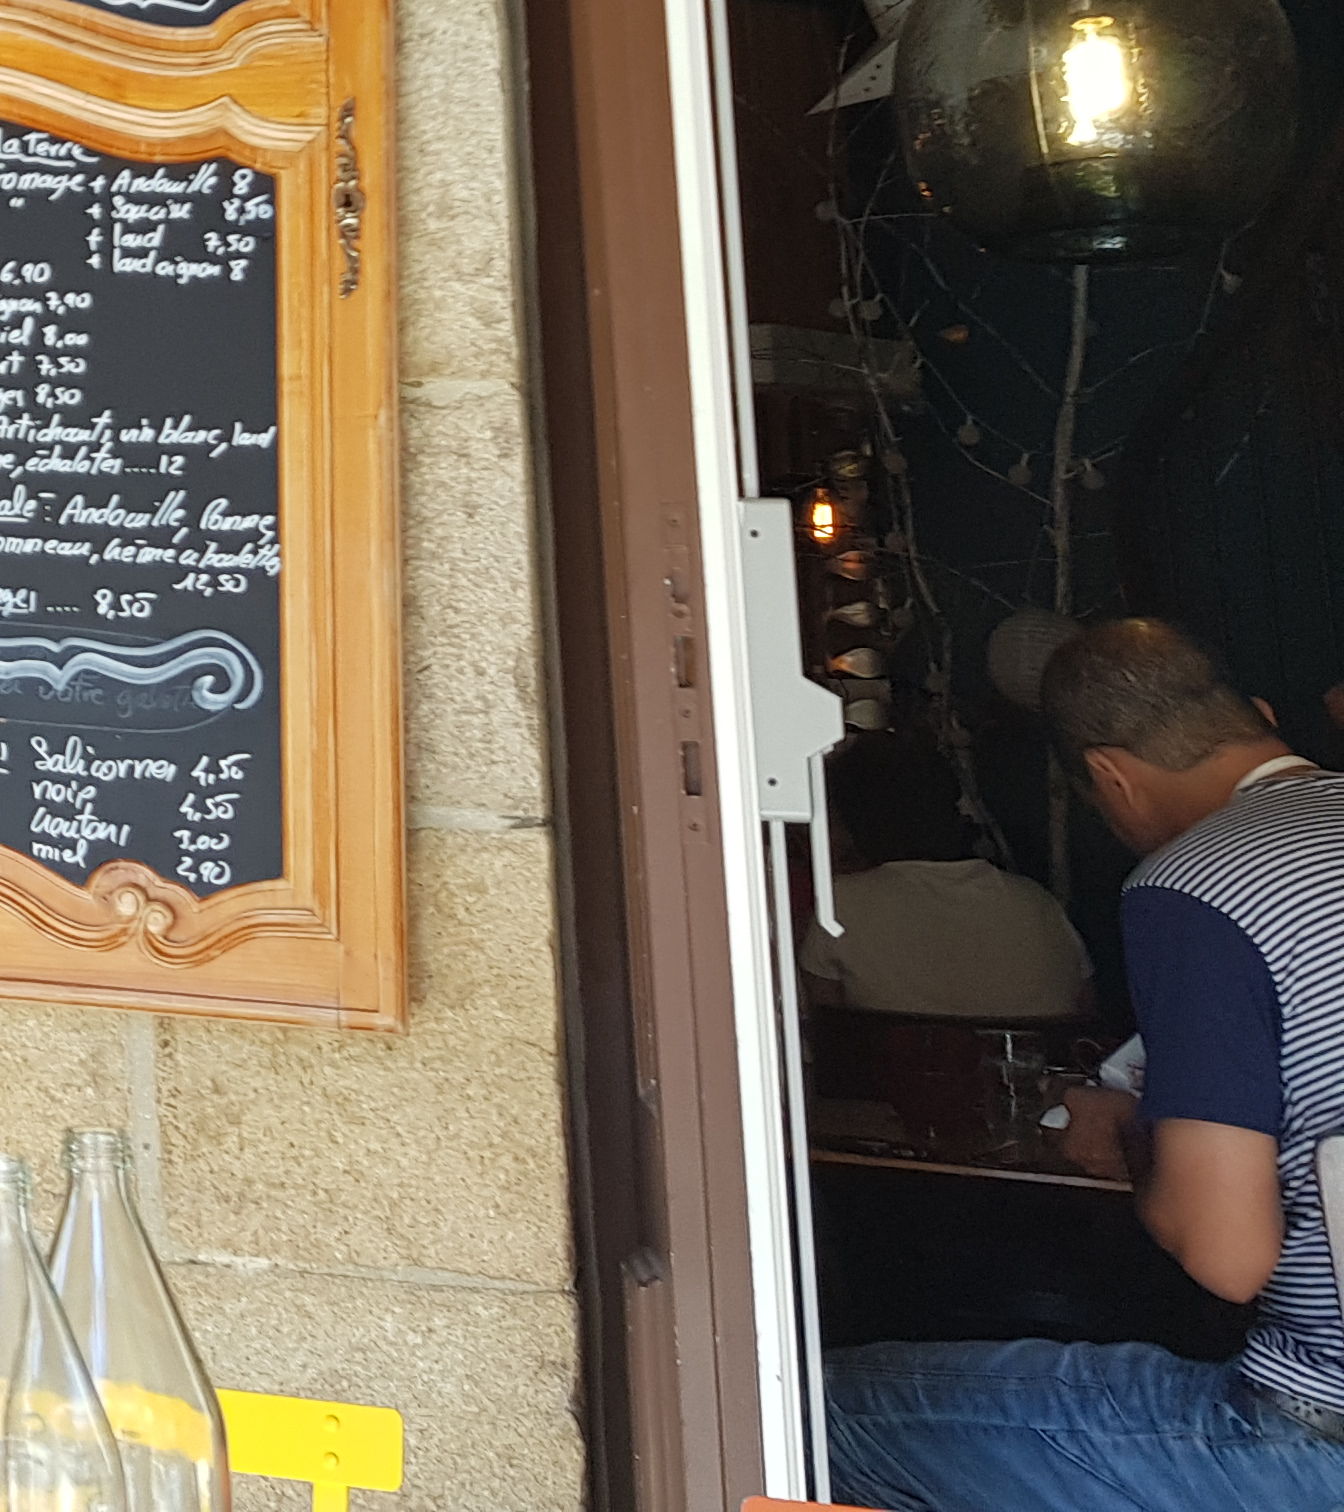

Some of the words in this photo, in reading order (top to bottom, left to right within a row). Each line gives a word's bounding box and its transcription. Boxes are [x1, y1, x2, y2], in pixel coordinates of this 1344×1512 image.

[110, 162, 219, 194] Andouille
[231, 167, 255, 195] 8
[222, 194, 274, 226] 8,50
[228, 258, 249, 282] 8
[119, 418, 156, 442] vin
[160, 455, 186, 474] 12
[172, 572, 250, 597] 12,50
[93, 588, 158, 619] 8,50
[30, 736, 178, 782] Salicornes
[32, 839, 89, 869] miel
